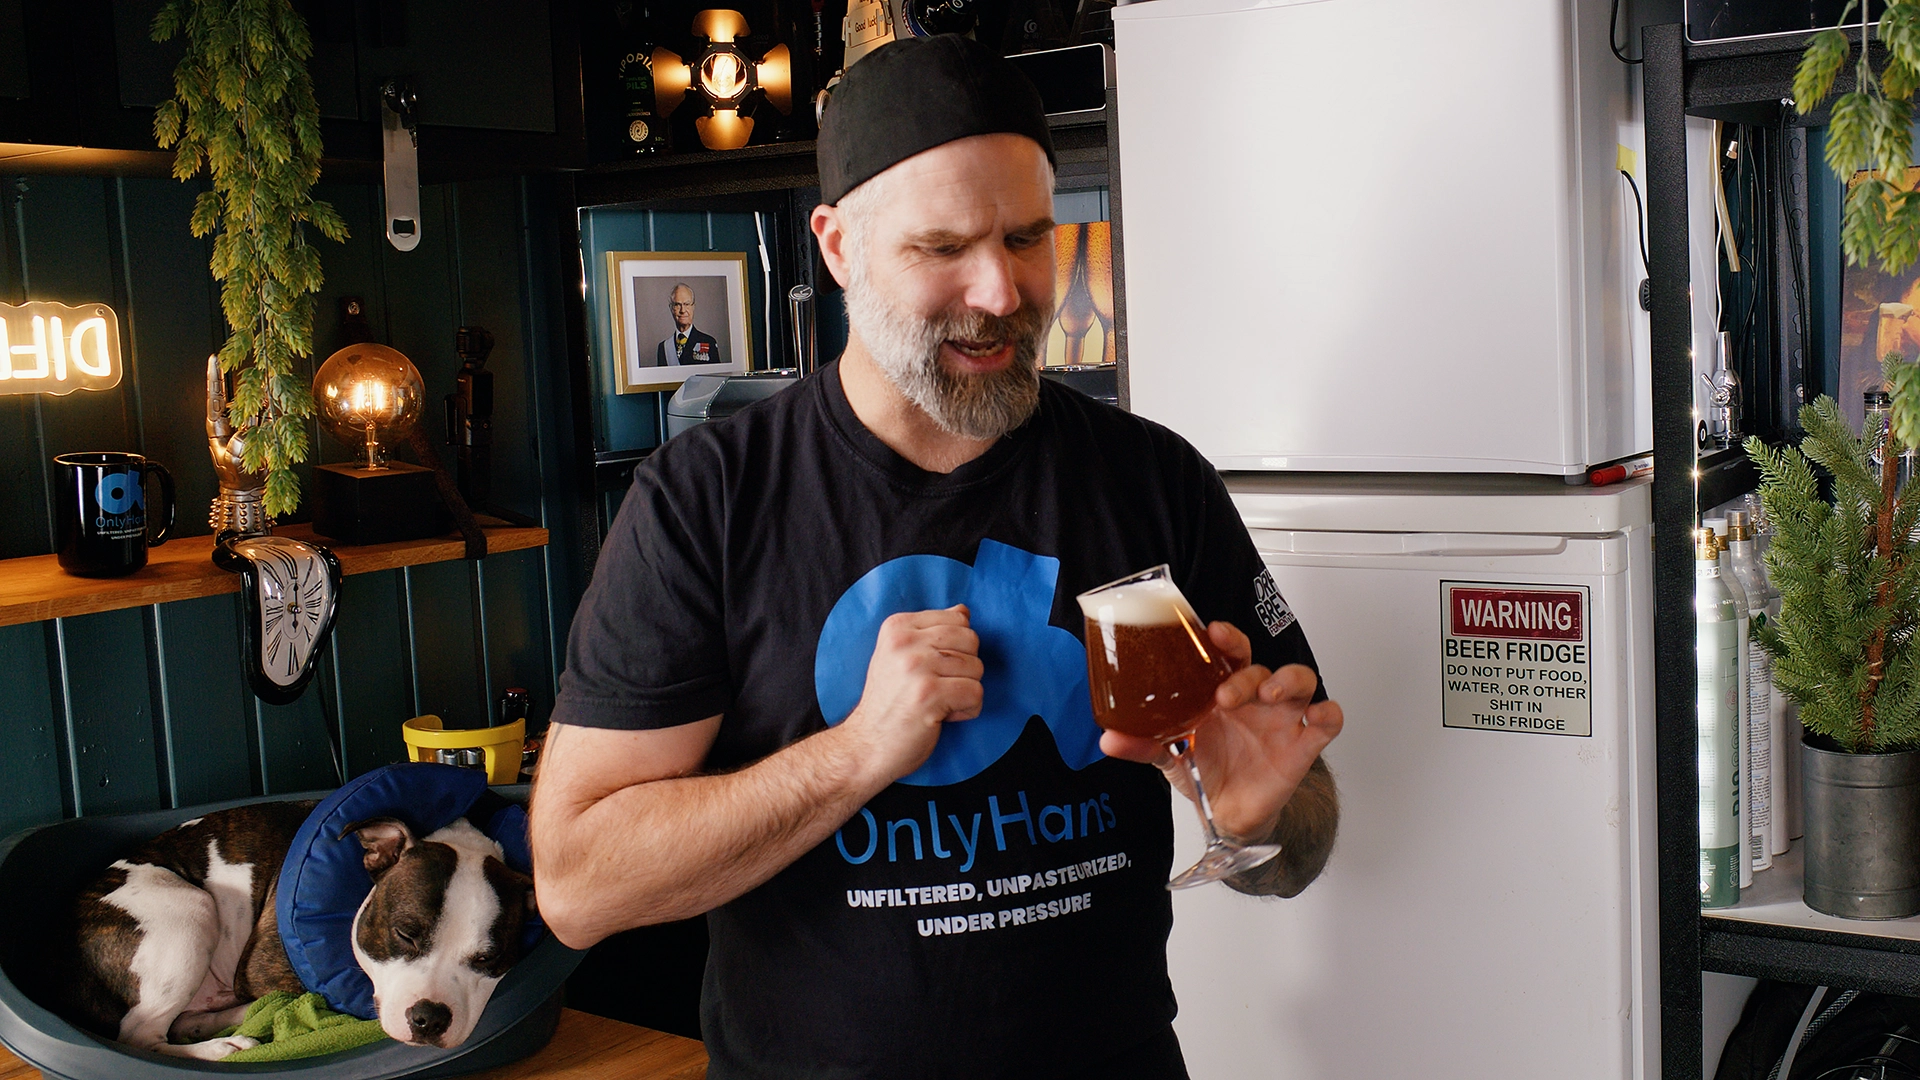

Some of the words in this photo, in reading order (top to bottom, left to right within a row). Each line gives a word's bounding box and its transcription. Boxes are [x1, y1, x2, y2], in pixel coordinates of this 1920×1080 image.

[626, 81, 648, 90] PILS
[1461, 599, 1571, 631] WARNING
[1446, 639, 1500, 660] BEER
[1507, 642, 1586, 664] FRIDGE
[1447, 664, 1468, 676] DO
[1472, 666, 1502, 677] NOT
[1506, 668, 1536, 680] PUT
[1539, 669, 1587, 685] FOOD,
[1448, 680, 1504, 697] WATER,
[1508, 684, 1529, 696] OR
[1533, 685, 1586, 699] OTHER
[1489, 699, 1524, 712] SHIT
[1528, 701, 1542, 713] IN
[1472, 714, 1505, 726] THIS
[1510, 716, 1565, 730] FRIDGE
[835, 791, 1117, 873] OnlyHans
[846, 882, 984, 909] UNFILTERED,
[986, 851, 1132, 898] UNPASTEURIZED,
[917, 911, 996, 937] UNDER
[998, 893, 1092, 927] PRESSURE
